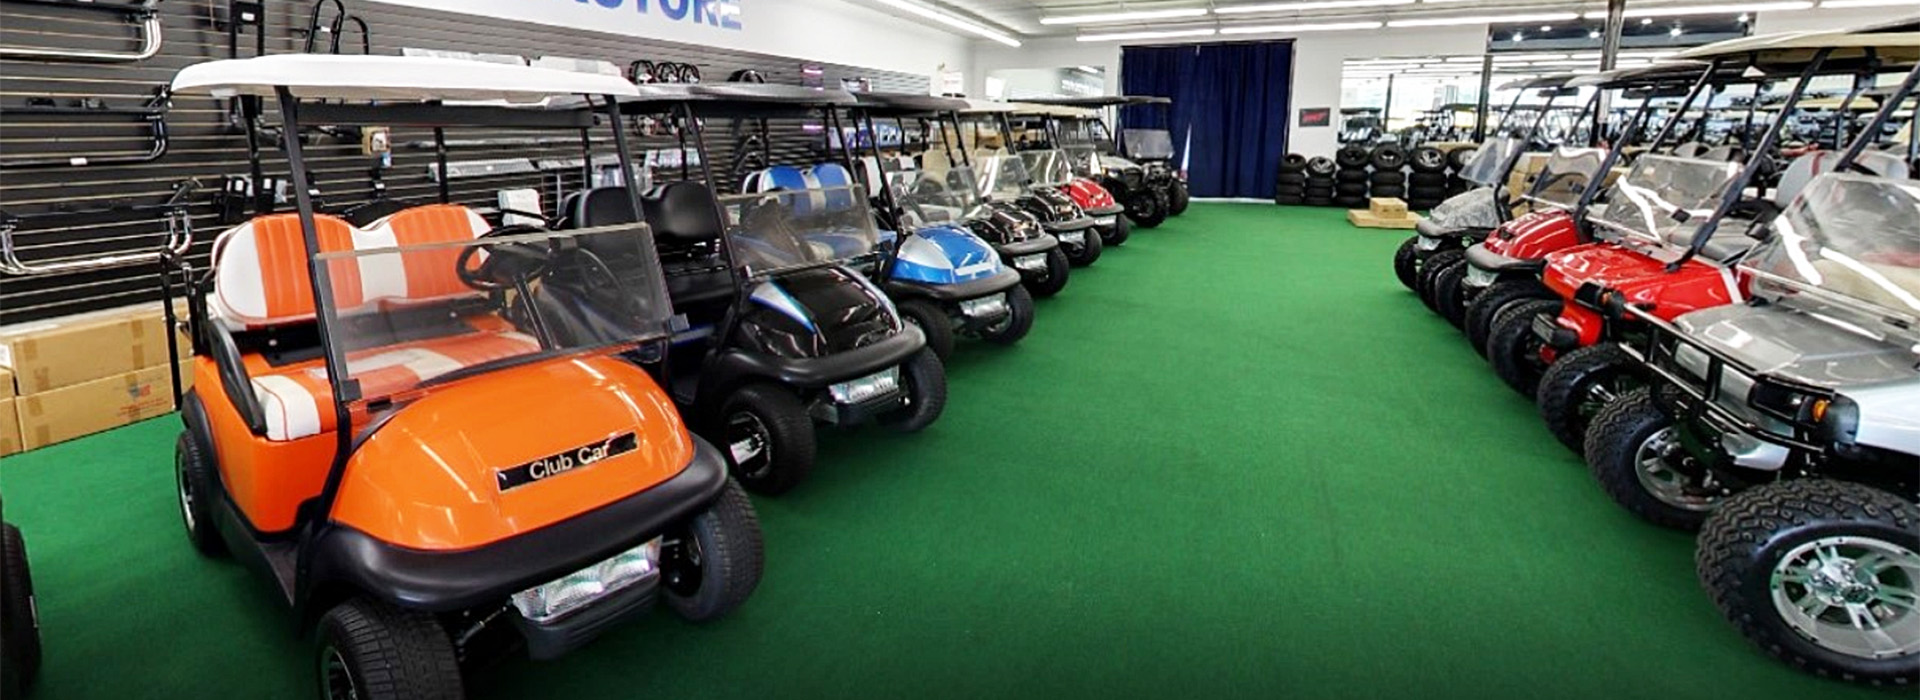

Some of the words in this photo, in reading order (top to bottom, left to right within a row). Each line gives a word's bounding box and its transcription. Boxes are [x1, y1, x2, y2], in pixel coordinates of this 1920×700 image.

[591, 0, 742, 31] ORE
[529, 454, 573, 479] Club
[577, 443, 609, 464] Car
